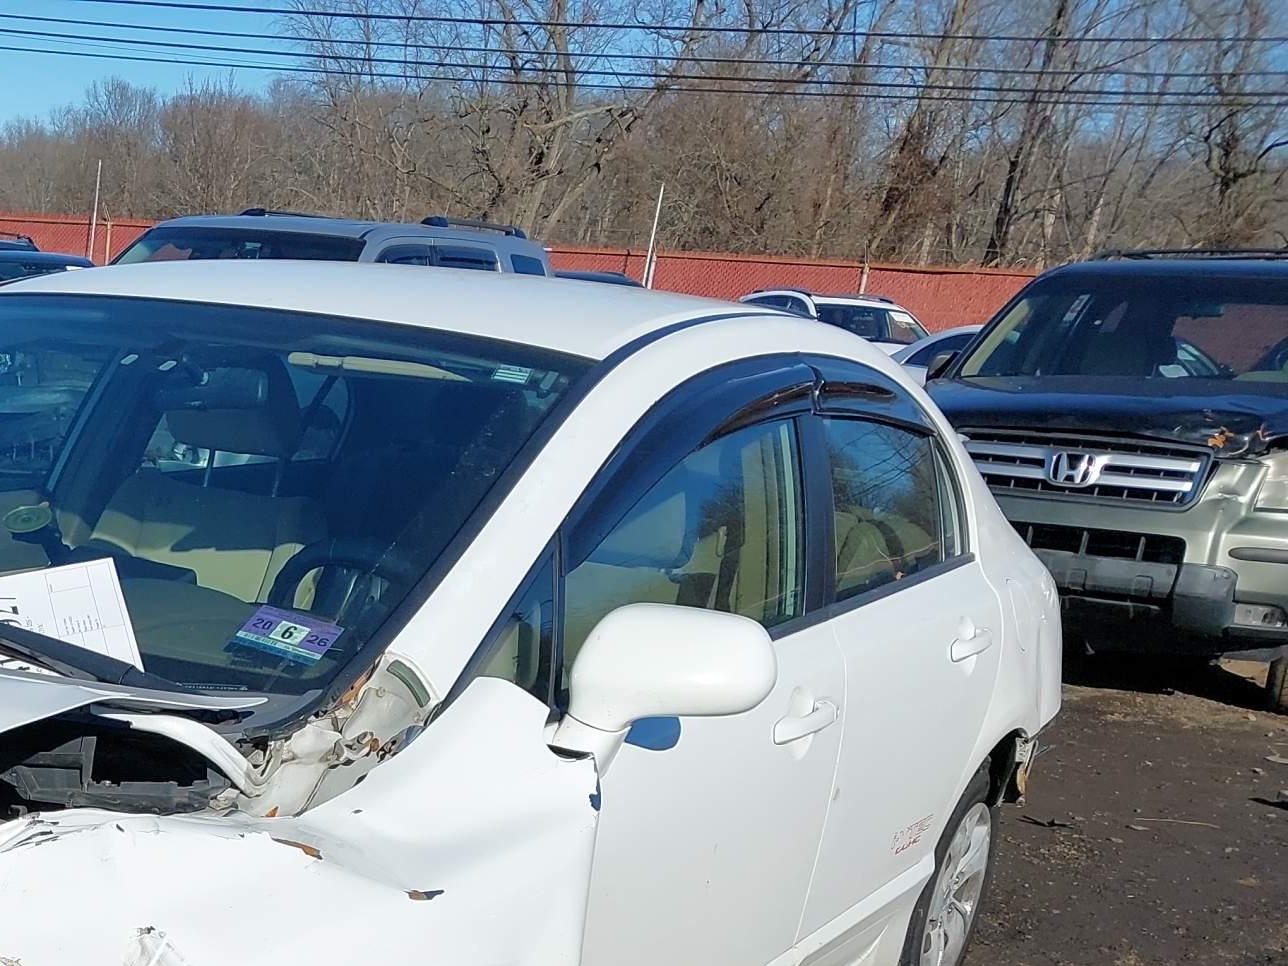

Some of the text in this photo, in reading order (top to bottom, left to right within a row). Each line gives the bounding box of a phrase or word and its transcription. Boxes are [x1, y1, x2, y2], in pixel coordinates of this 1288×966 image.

[252, 617, 273, 631] 20
[280, 625, 298, 640] 6
[306, 634, 330, 648] 26
